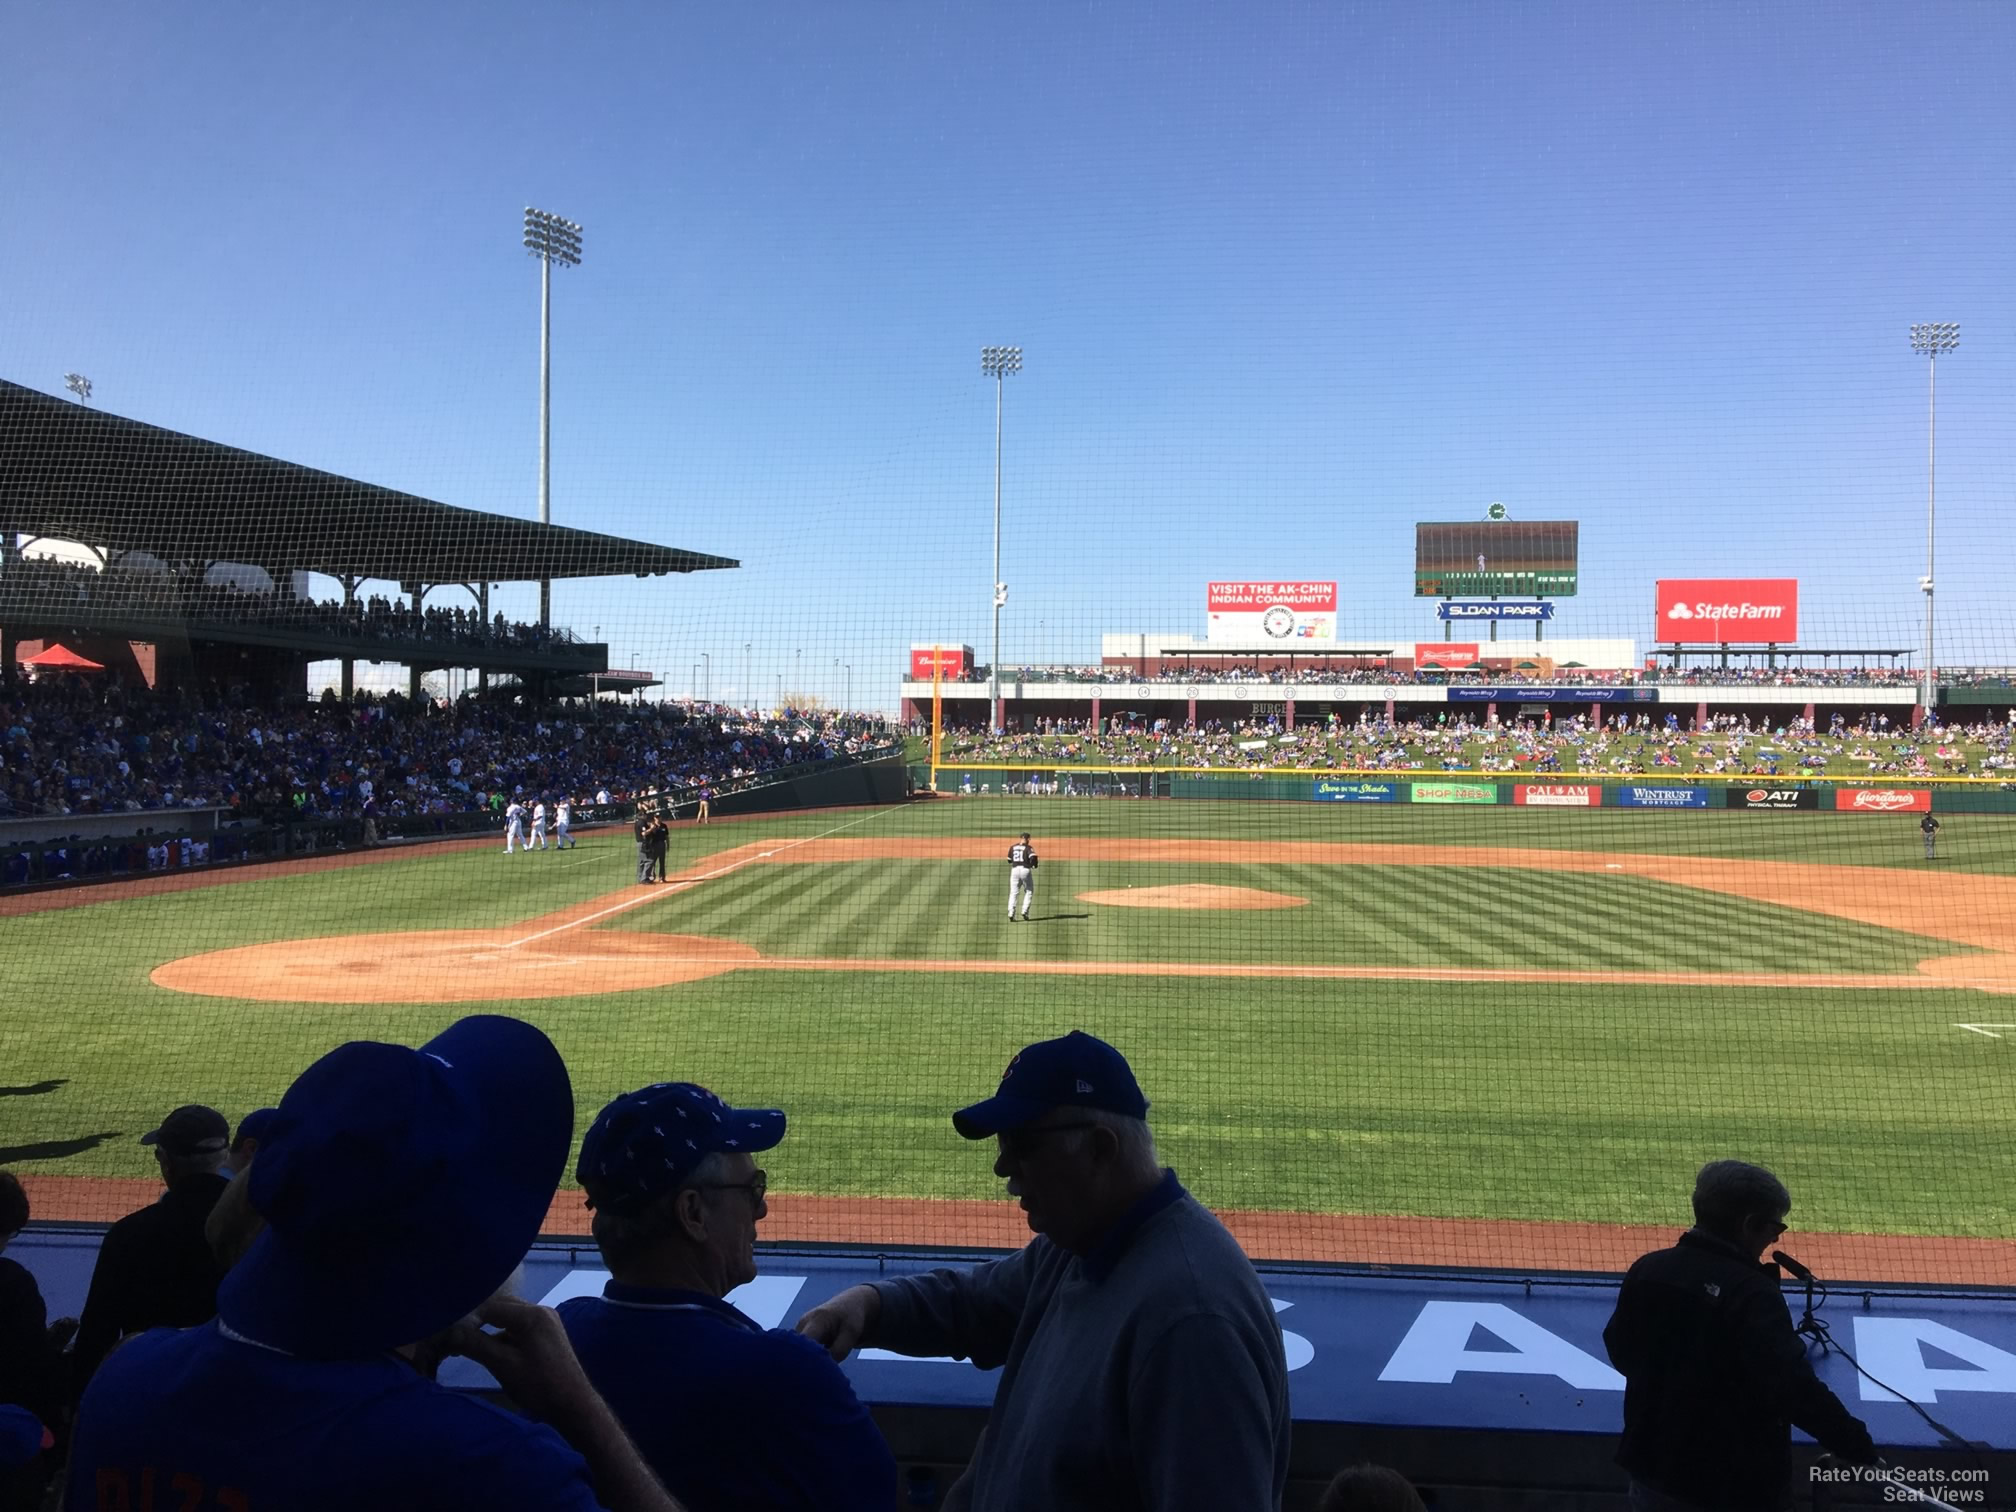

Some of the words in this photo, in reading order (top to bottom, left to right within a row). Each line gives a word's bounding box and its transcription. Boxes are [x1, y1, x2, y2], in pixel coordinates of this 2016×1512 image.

[1211, 584, 1245, 594] VISIT
[1249, 584, 1275, 594] THE
[1278, 584, 1333, 595] AK-CHIN
[1211, 595, 1253, 604] INDIAN
[1256, 595, 1333, 604] COMMUNITY
[1449, 606, 1500, 616] SLOAN
[1502, 606, 1543, 616] PARK
[1252, 703, 1296, 714] BURGE
[1319, 783, 1341, 793] Save
[1526, 786, 1556, 796] CAL
[1567, 787, 1588, 796] AM
[1416, 788, 1450, 798] SHOP
[1455, 789, 1493, 799] MESA
[1633, 788, 1693, 799] WINTRUST
[1767, 791, 1799, 801] ATI
[1013, 850, 1024, 862] 21
